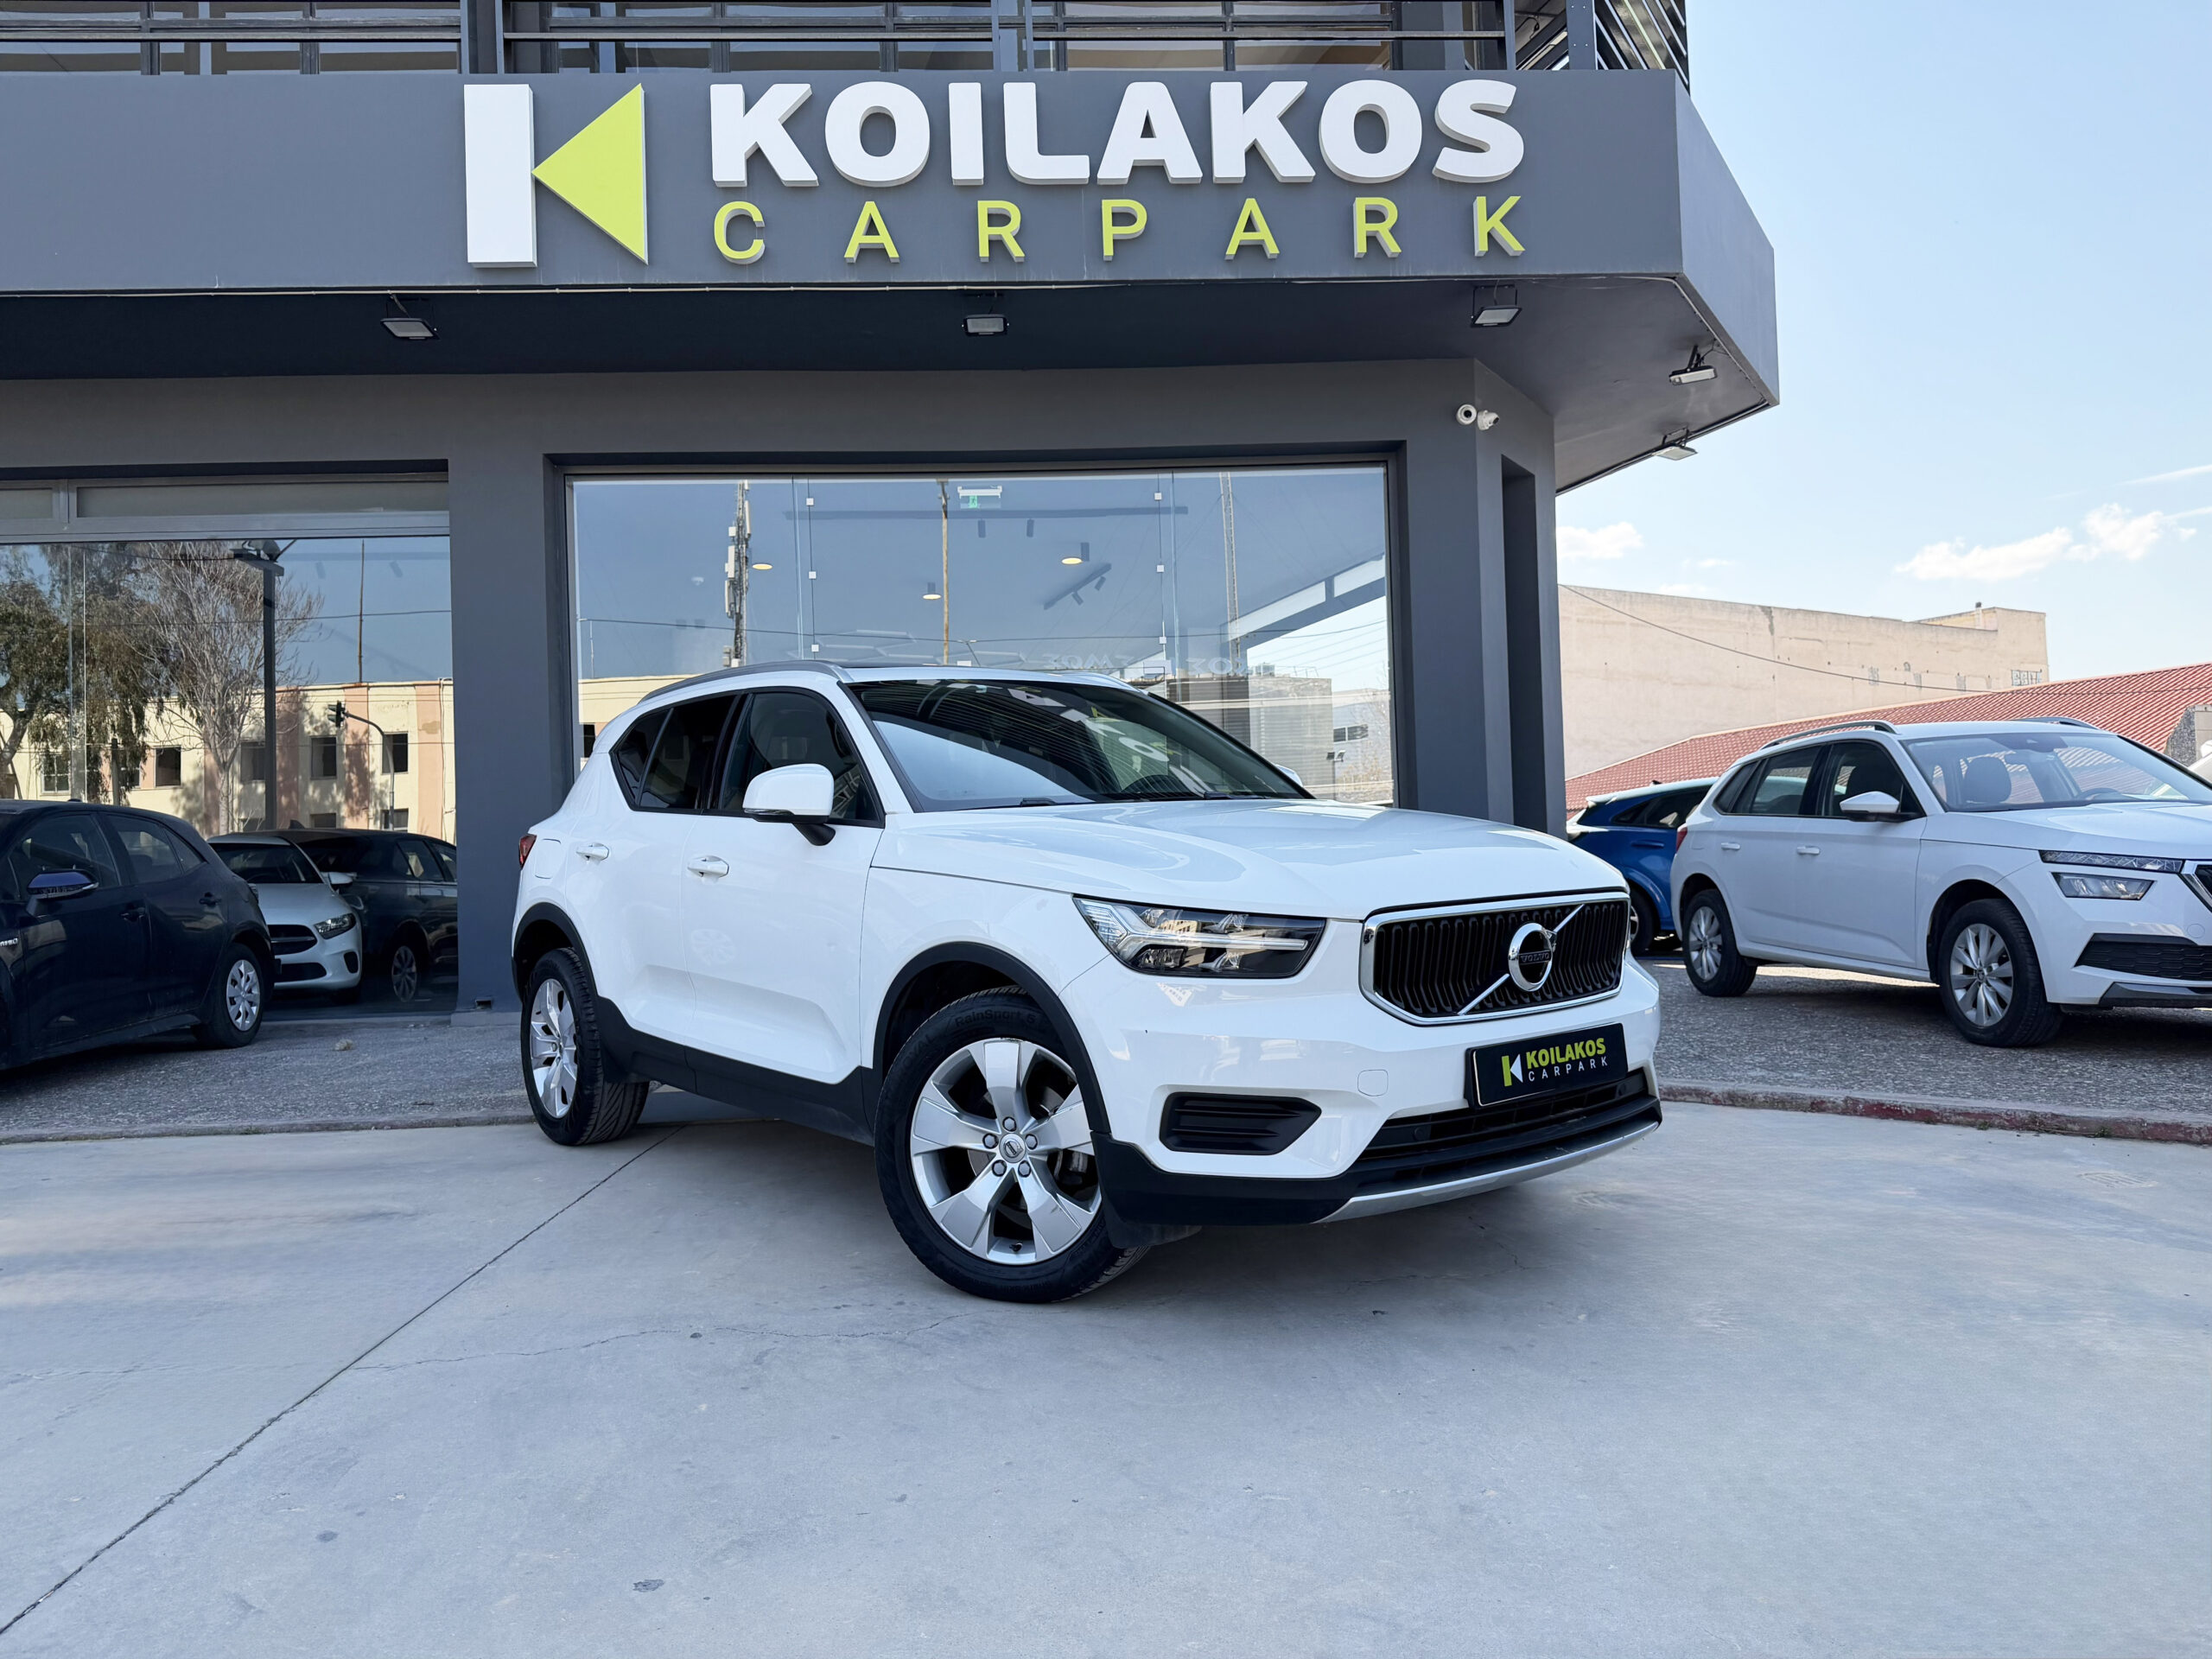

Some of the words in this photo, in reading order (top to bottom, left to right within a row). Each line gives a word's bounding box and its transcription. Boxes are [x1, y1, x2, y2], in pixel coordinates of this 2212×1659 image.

[710, 79, 1525, 188] KOILAKOS
[713, 194, 1526, 265] CARPARK
[1521, 952, 1550, 963] VOLVO
[1526, 1038, 1606, 1070] KOILAKOS
[1528, 1056, 1608, 1082] CARPARK
